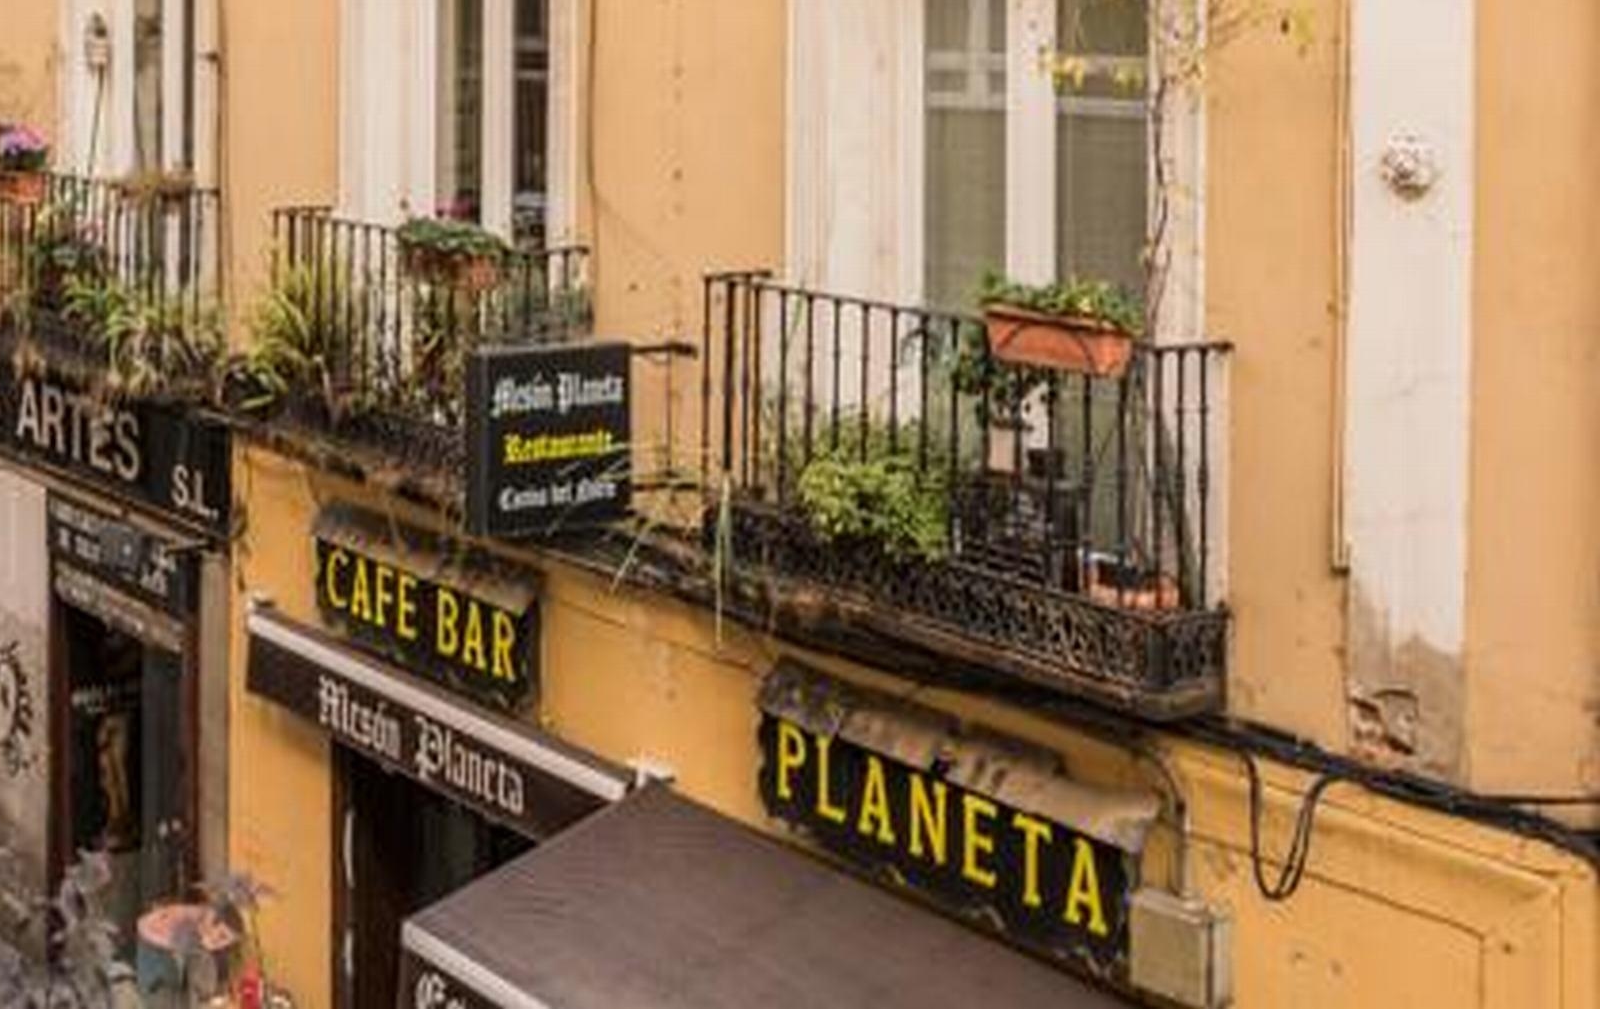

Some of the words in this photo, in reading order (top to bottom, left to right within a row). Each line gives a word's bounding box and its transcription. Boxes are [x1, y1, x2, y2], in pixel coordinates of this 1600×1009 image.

[16, 379, 140, 481] ARTES
[557, 372, 623, 415] Planeta
[326, 550, 418, 640] CAFE
[437, 587, 516, 682] BAR
[318, 674, 401, 761] Mesón
[414, 714, 525, 815] Planeta
[776, 719, 1108, 937] PLANETA
